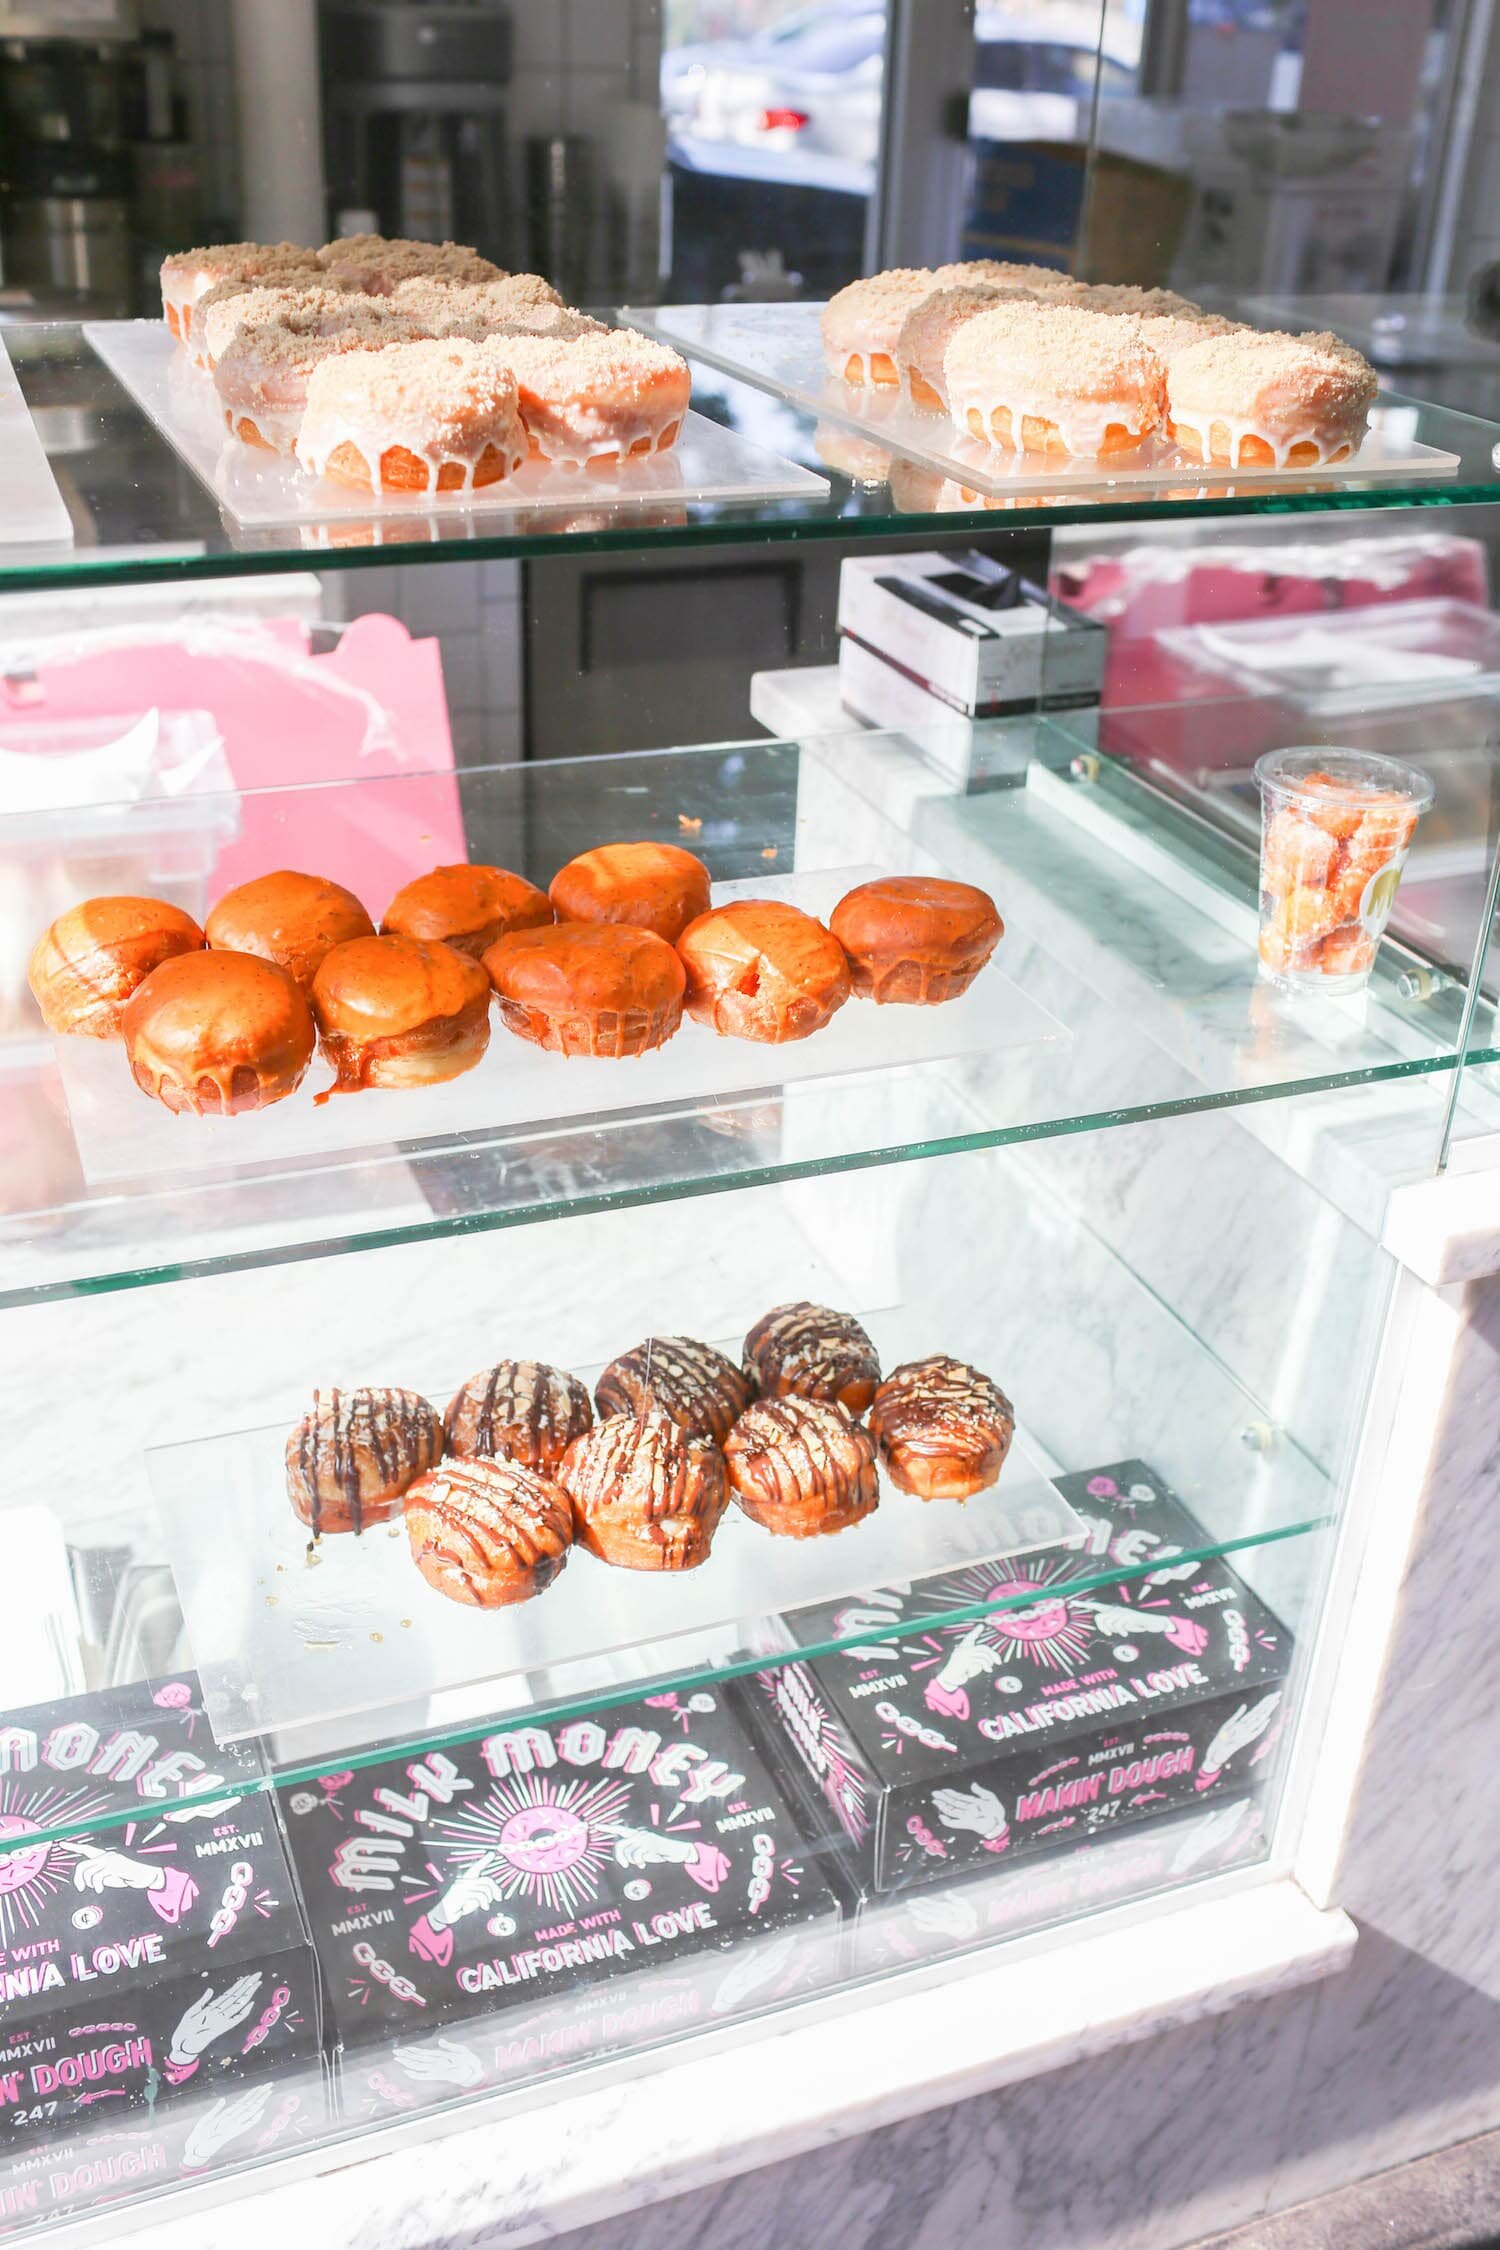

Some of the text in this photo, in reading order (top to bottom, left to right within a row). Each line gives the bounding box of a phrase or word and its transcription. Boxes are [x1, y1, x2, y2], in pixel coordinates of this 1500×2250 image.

[848, 1674, 908, 1699] MMXVII
[1040, 1667, 1118, 1697] MADE WITH
[977, 1662, 1209, 1740] CALIFORNIA LOVE
[1087, 1742, 1134, 1767] MMXVII
[1107, 1745, 1195, 1795] DOUGH
[328, 1752, 474, 1893] MILK
[480, 1721, 746, 1803] MONEY
[715, 1807, 776, 1834] MMXVII
[194, 1832, 264, 1858] MMXVII
[331, 1909, 395, 1937] MMXVII
[534, 1908, 622, 1942] MADE WITH
[11, 1938, 61, 1962] WITH
[70, 1932, 167, 1985] LOVE
[456, 1900, 718, 1994] CALIFORNIA LOVE
[30, 2035, 153, 2096] DOUGH
[12, 2100, 58, 2126] 247
[12, 2147, 74, 2176] MMXVII
[50, 2143, 167, 2200] DOUGH
